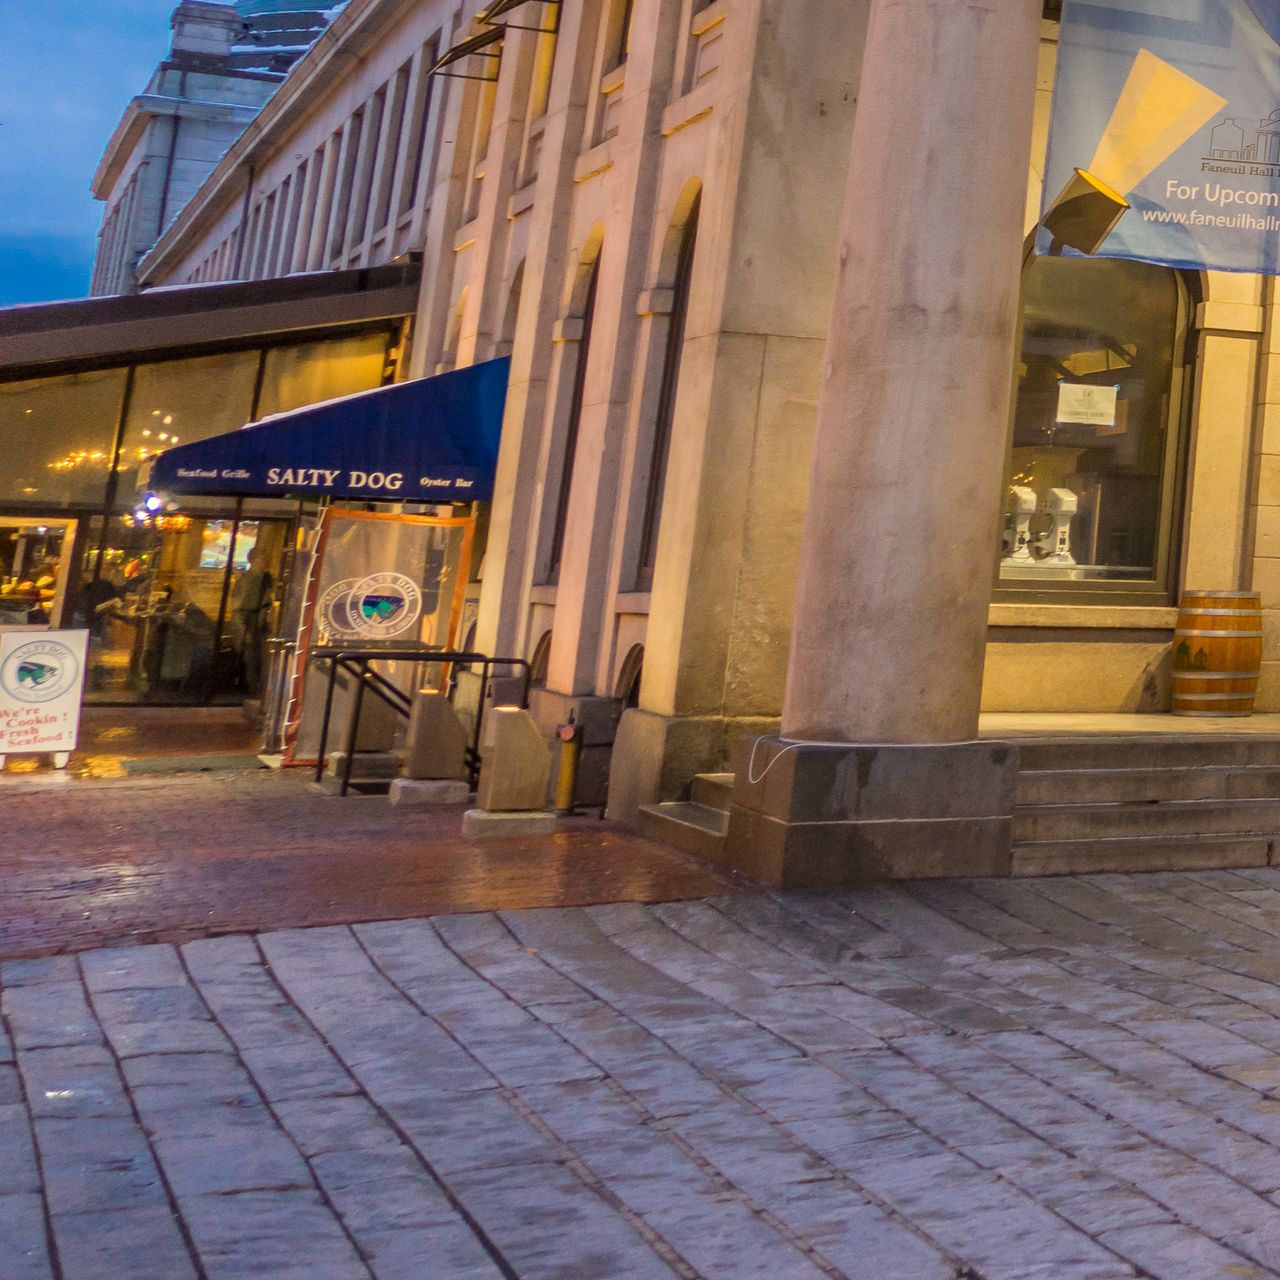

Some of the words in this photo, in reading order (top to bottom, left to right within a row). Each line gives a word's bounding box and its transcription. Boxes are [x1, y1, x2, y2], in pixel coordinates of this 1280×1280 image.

[1201, 162, 1247, 176] Faneuil
[1249, 166, 1274, 178] Hall
[1166, 180, 1199, 200] For
[266, 467, 341, 487] SALTY
[347, 470, 404, 490] DOG
[419, 476, 452, 487] Oyster
[455, 478, 475, 487] Bar
